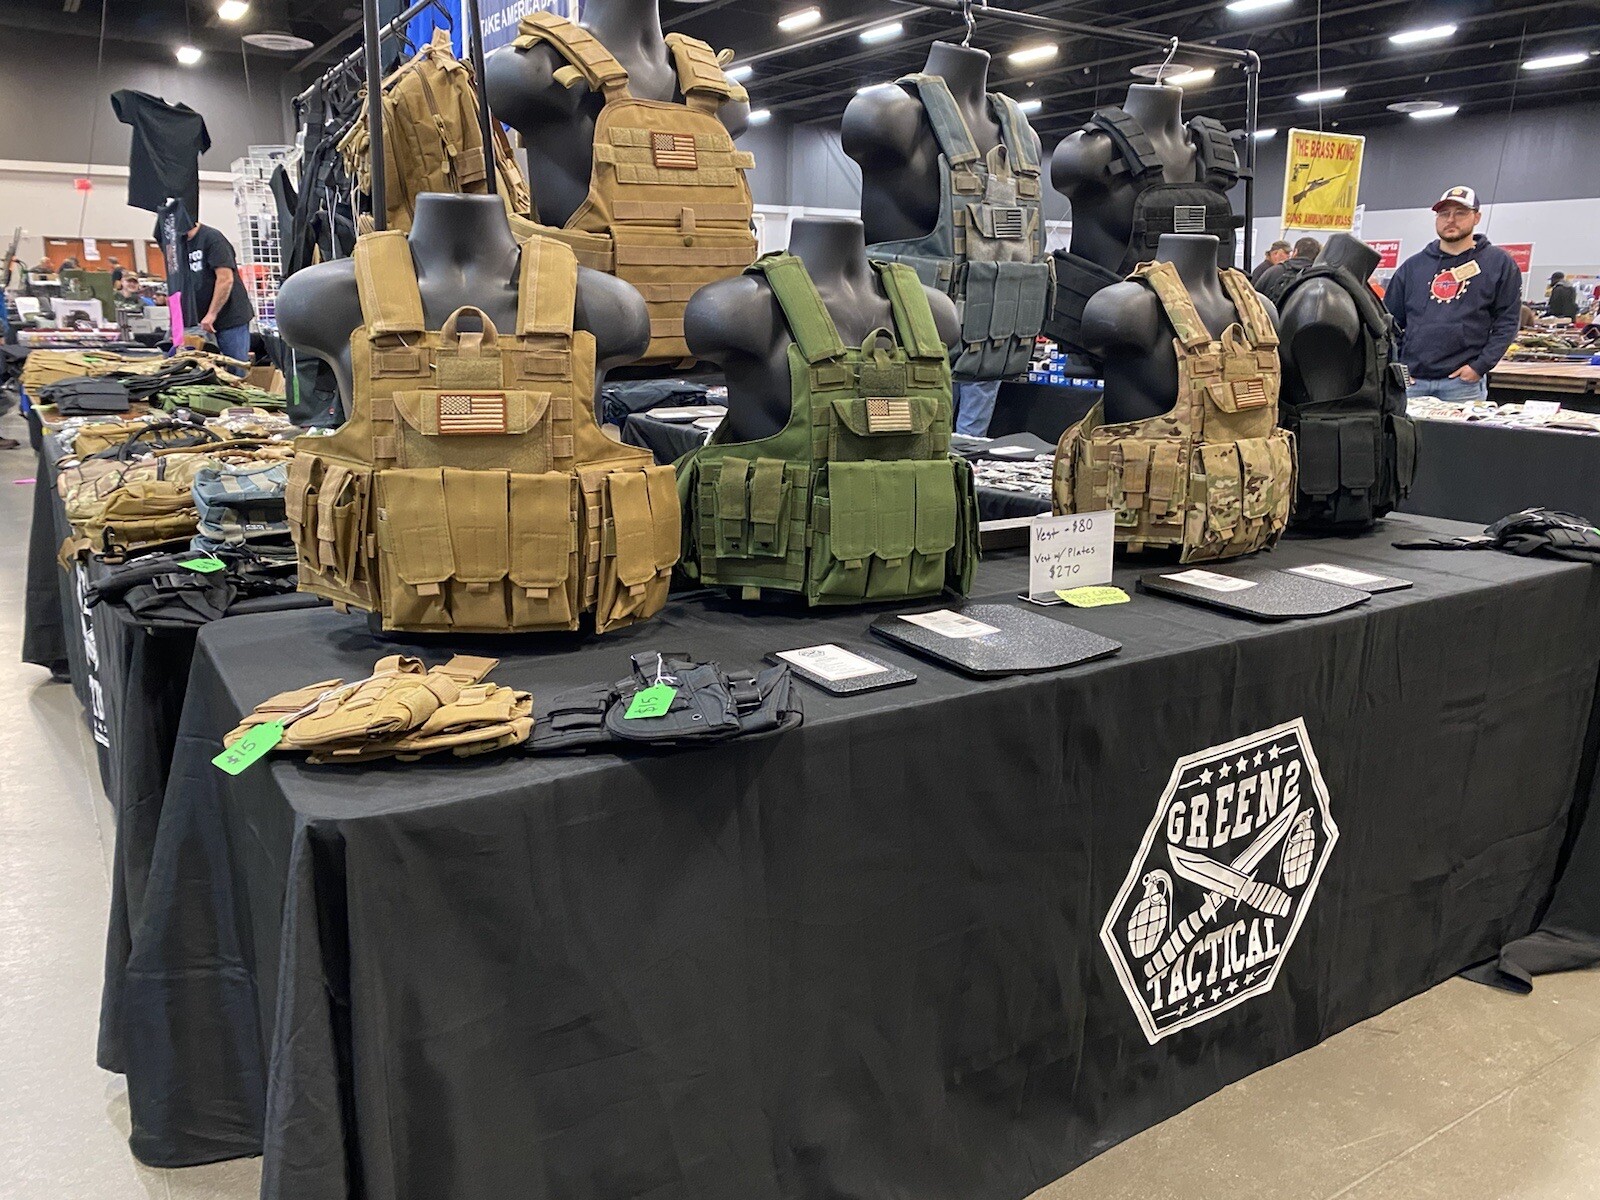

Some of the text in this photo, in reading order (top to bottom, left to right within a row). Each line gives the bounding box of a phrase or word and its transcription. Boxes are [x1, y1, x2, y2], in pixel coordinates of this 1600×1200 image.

[481, 12, 501, 37] TAKE
[1295, 138, 1358, 161] THE BRASS KING
[1285, 212, 1302, 224] GUNS
[1036, 527, 1059, 541] Vest
[1072, 518, 1093, 533] $80
[1034, 553, 1051, 563] Vest
[1049, 564, 1080, 579] $270
[226, 739, 256, 765] $15
[1166, 759, 1302, 849] GREEN2
[1145, 917, 1281, 1012] TACTICAL
